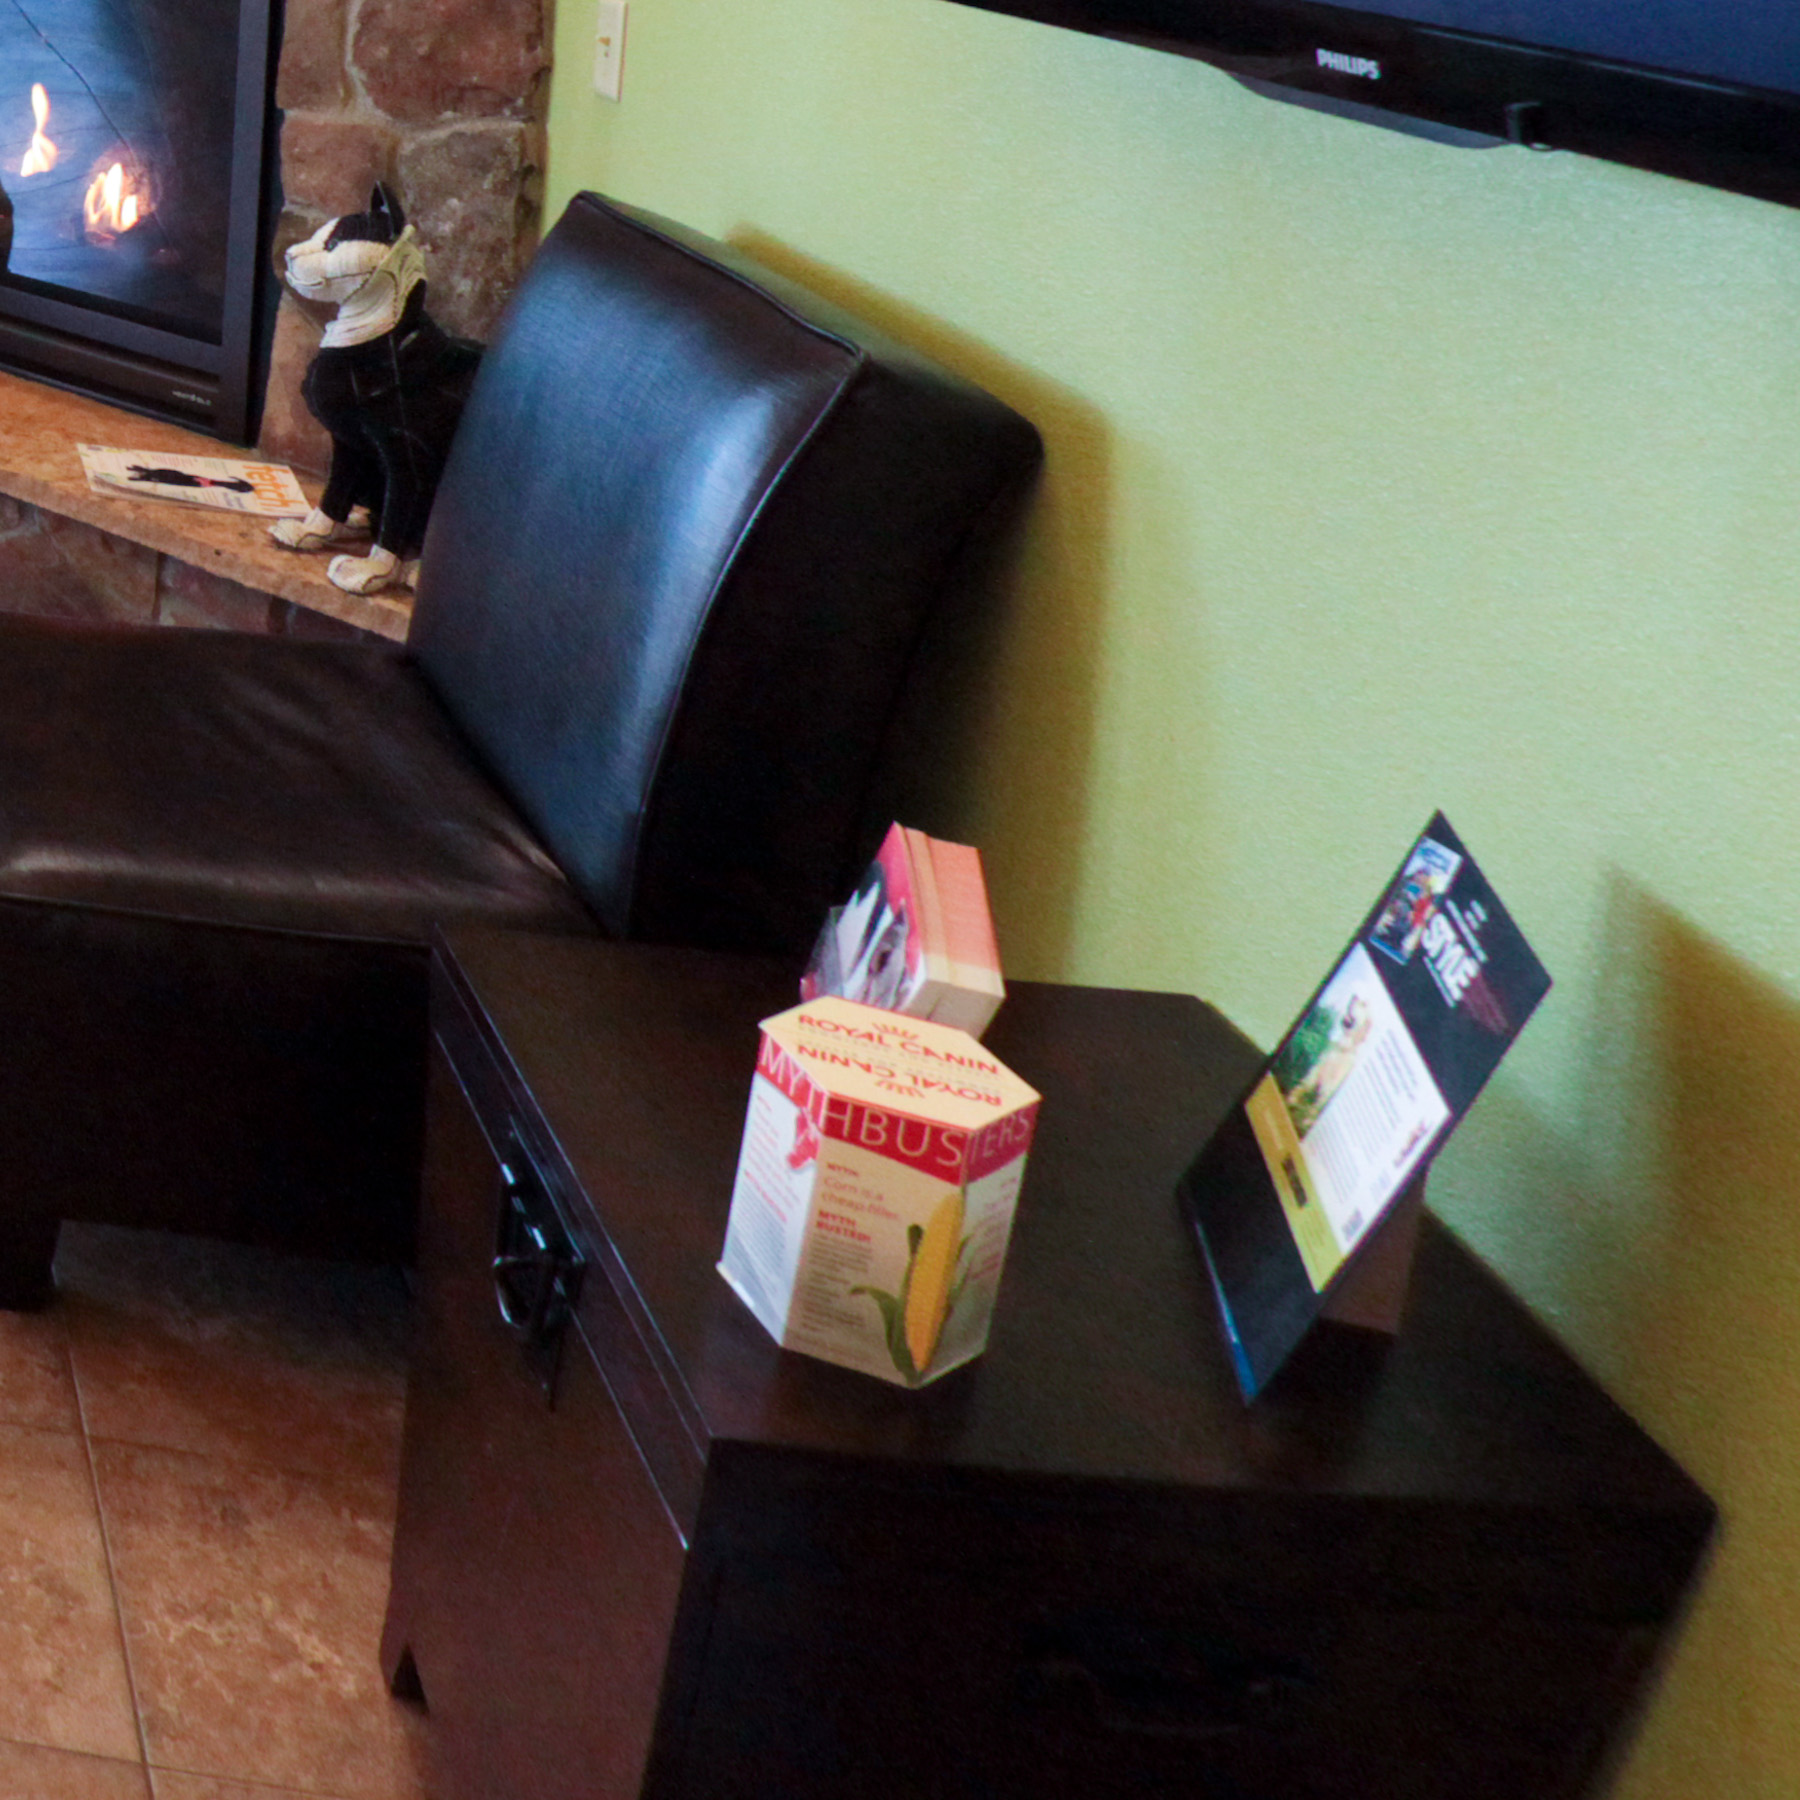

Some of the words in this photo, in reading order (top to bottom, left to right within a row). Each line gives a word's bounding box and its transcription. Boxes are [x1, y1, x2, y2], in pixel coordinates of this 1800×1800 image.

[1316, 48, 1381, 80] PHILIPS
[797, 1044, 896, 1078] CANIN
[798, 1015, 894, 1047] ROYAL
[899, 1040, 998, 1075] CANIN
[908, 1074, 1002, 1106] ROYAL
[824, 1176, 856, 1193] Corn
